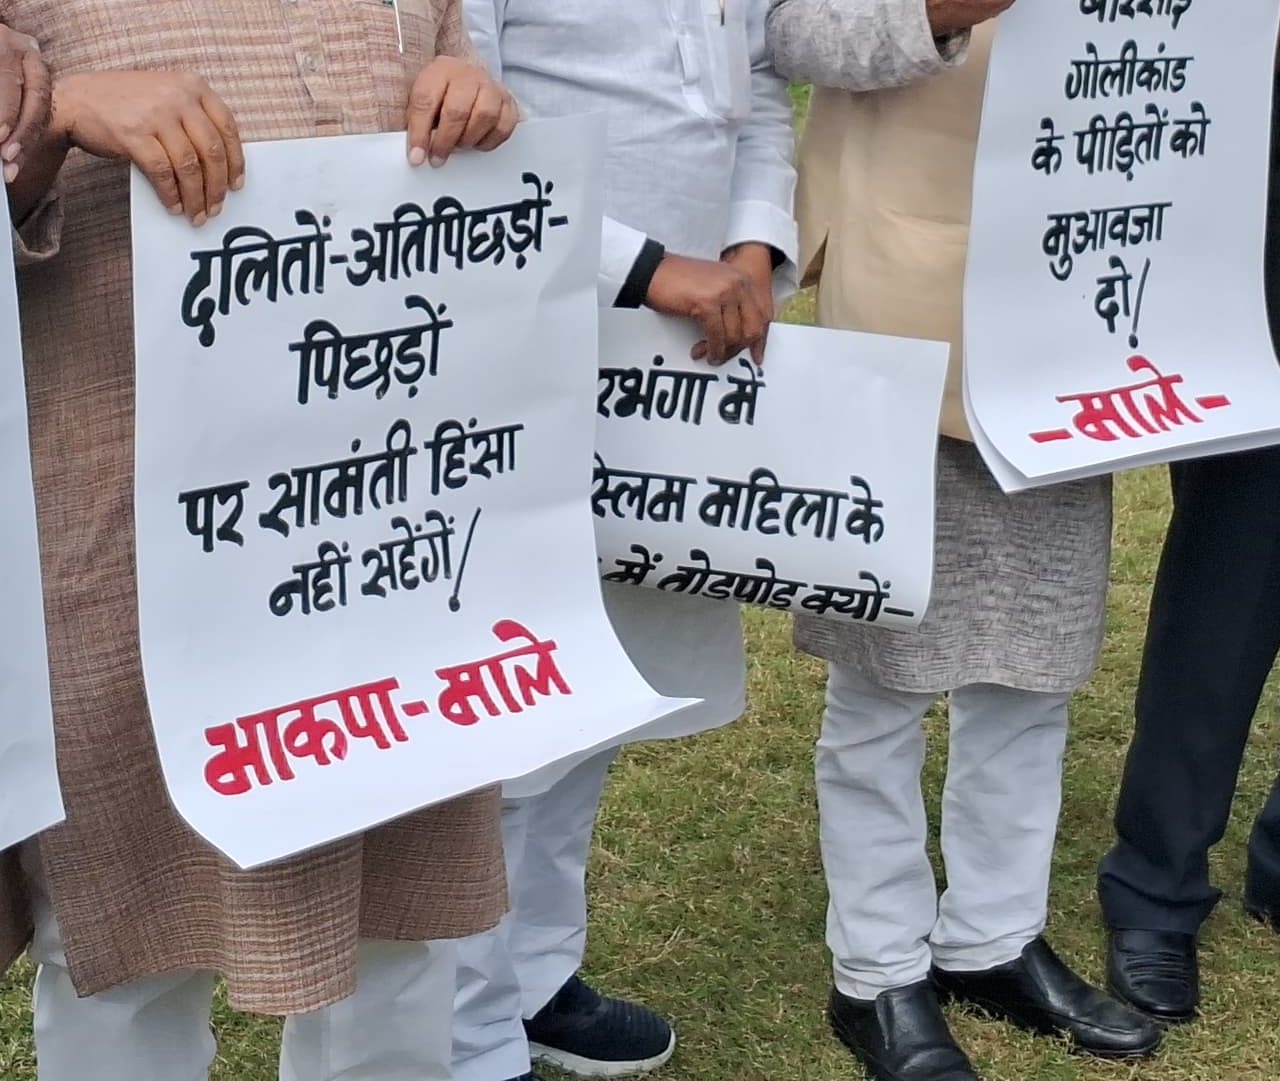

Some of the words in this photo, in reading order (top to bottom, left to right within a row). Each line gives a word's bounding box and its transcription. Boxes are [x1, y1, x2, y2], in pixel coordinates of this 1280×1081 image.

[1065, 40, 1194, 100] गोलीकांड
[1031, 117, 1065, 175] के
[1170, 102, 1211, 158] को
[1042, 202, 1172, 281] मुआवजा
[289, 295, 454, 405] पिछड़ों
[597, 355, 719, 426] रभंगा
[718, 357, 765, 426] में
[178, 481, 250, 553] पर
[258, 419, 422, 538] सामंती
[423, 418, 524, 496] हिंसा
[699, 468, 849, 540] महिला
[846, 476, 884, 544] के
[269, 541, 352, 617] नहीं
